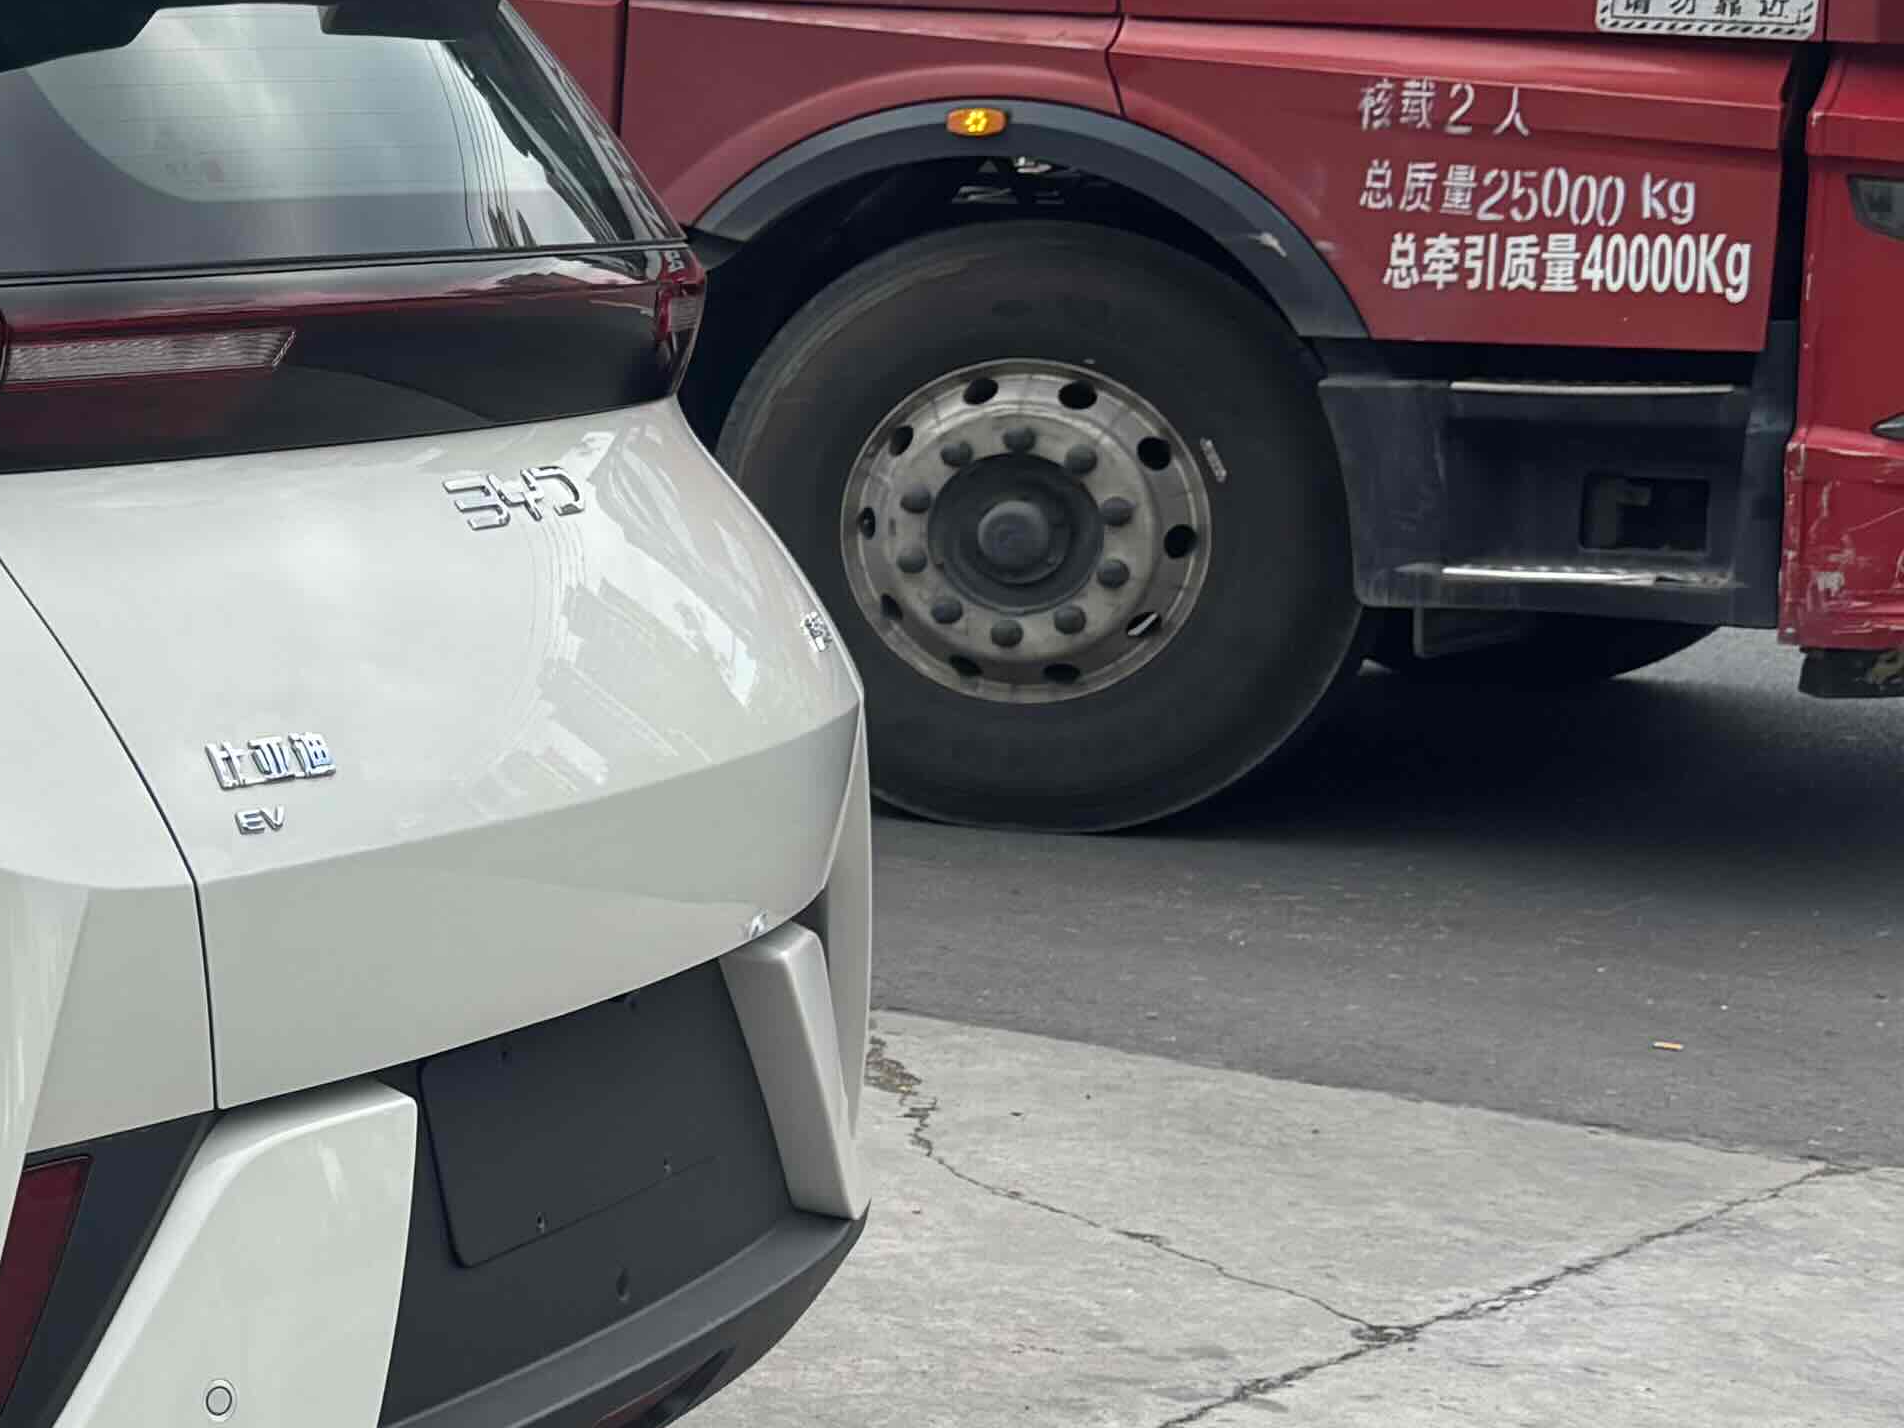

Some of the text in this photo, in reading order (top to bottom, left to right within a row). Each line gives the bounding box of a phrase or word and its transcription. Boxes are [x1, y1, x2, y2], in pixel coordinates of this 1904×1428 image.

[1359, 159, 1626, 227] 总质量25000
[1382, 231, 1753, 303] 总牵引质量40000Kg
[442, 465, 585, 531] BYD
[204, 732, 336, 791] 比亚迪
[234, 805, 285, 835] EV
